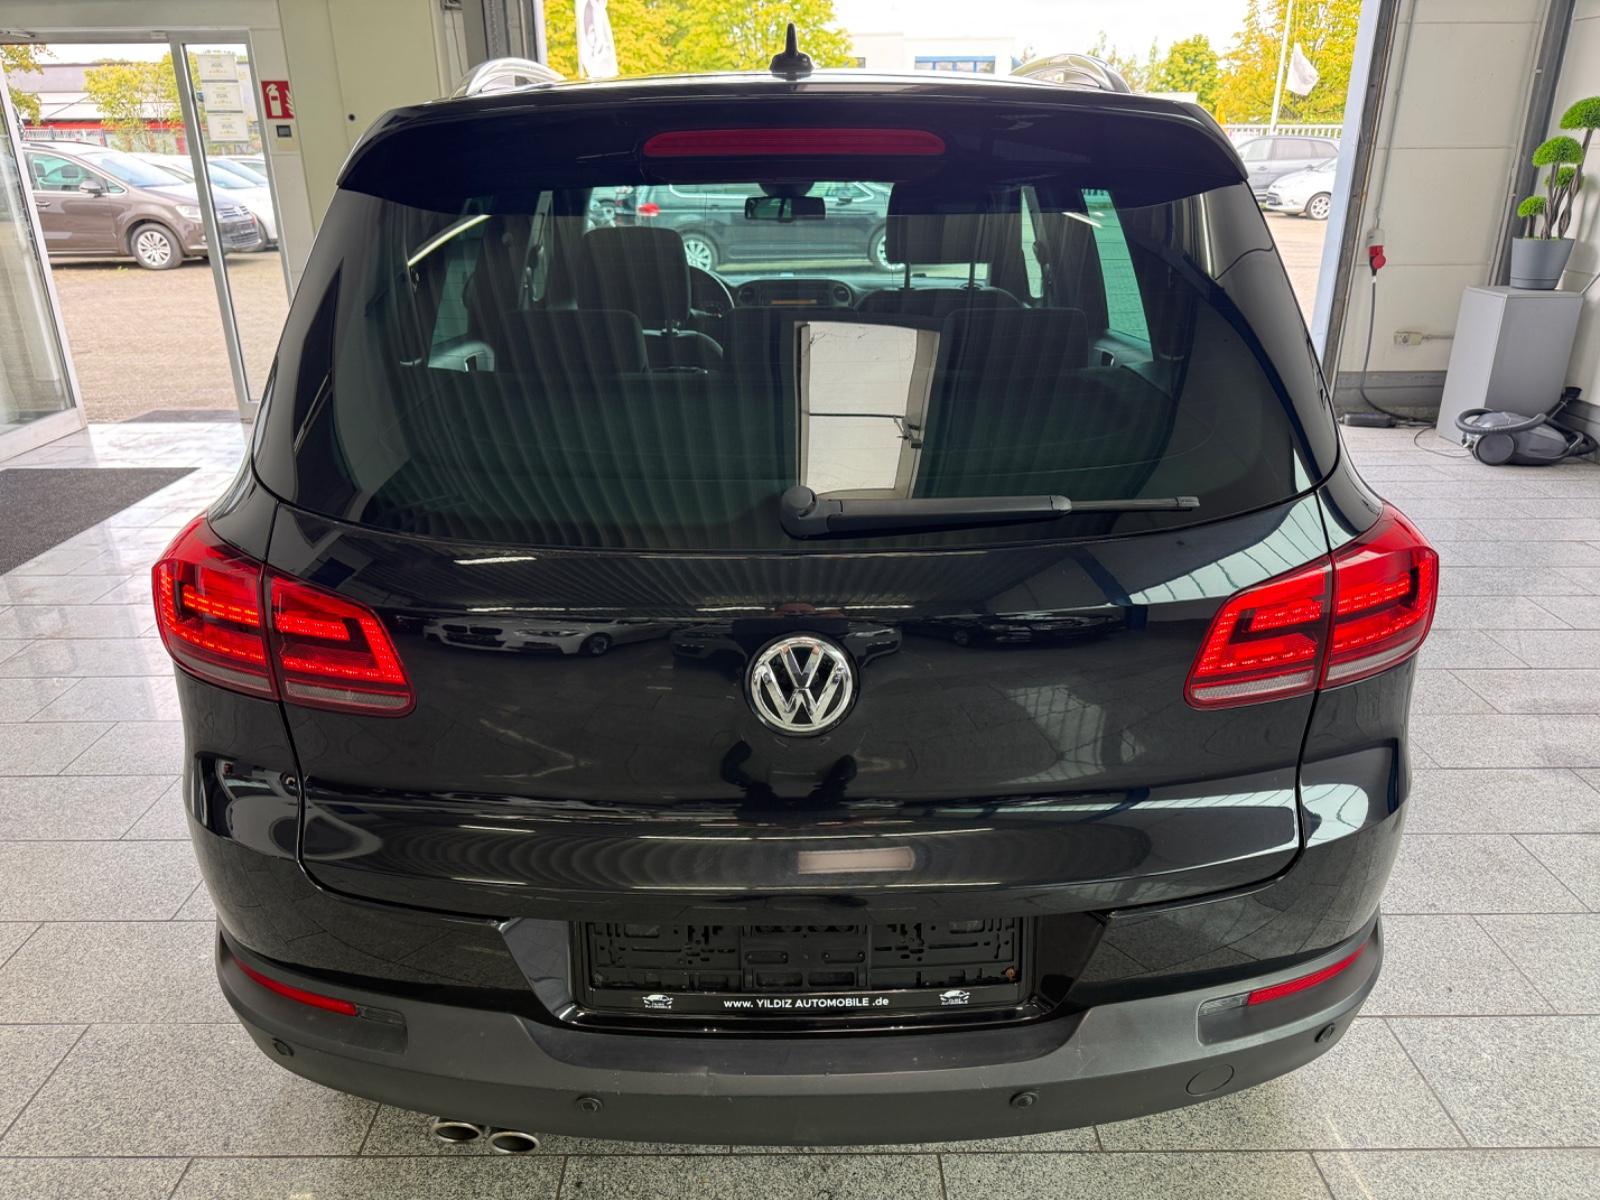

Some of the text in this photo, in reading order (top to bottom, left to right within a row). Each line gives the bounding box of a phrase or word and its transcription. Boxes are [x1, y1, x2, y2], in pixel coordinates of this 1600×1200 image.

[753, 638, 852, 731] VW
[723, 996, 890, 1008] www. YILDIZ AUTOMOBILE .de
